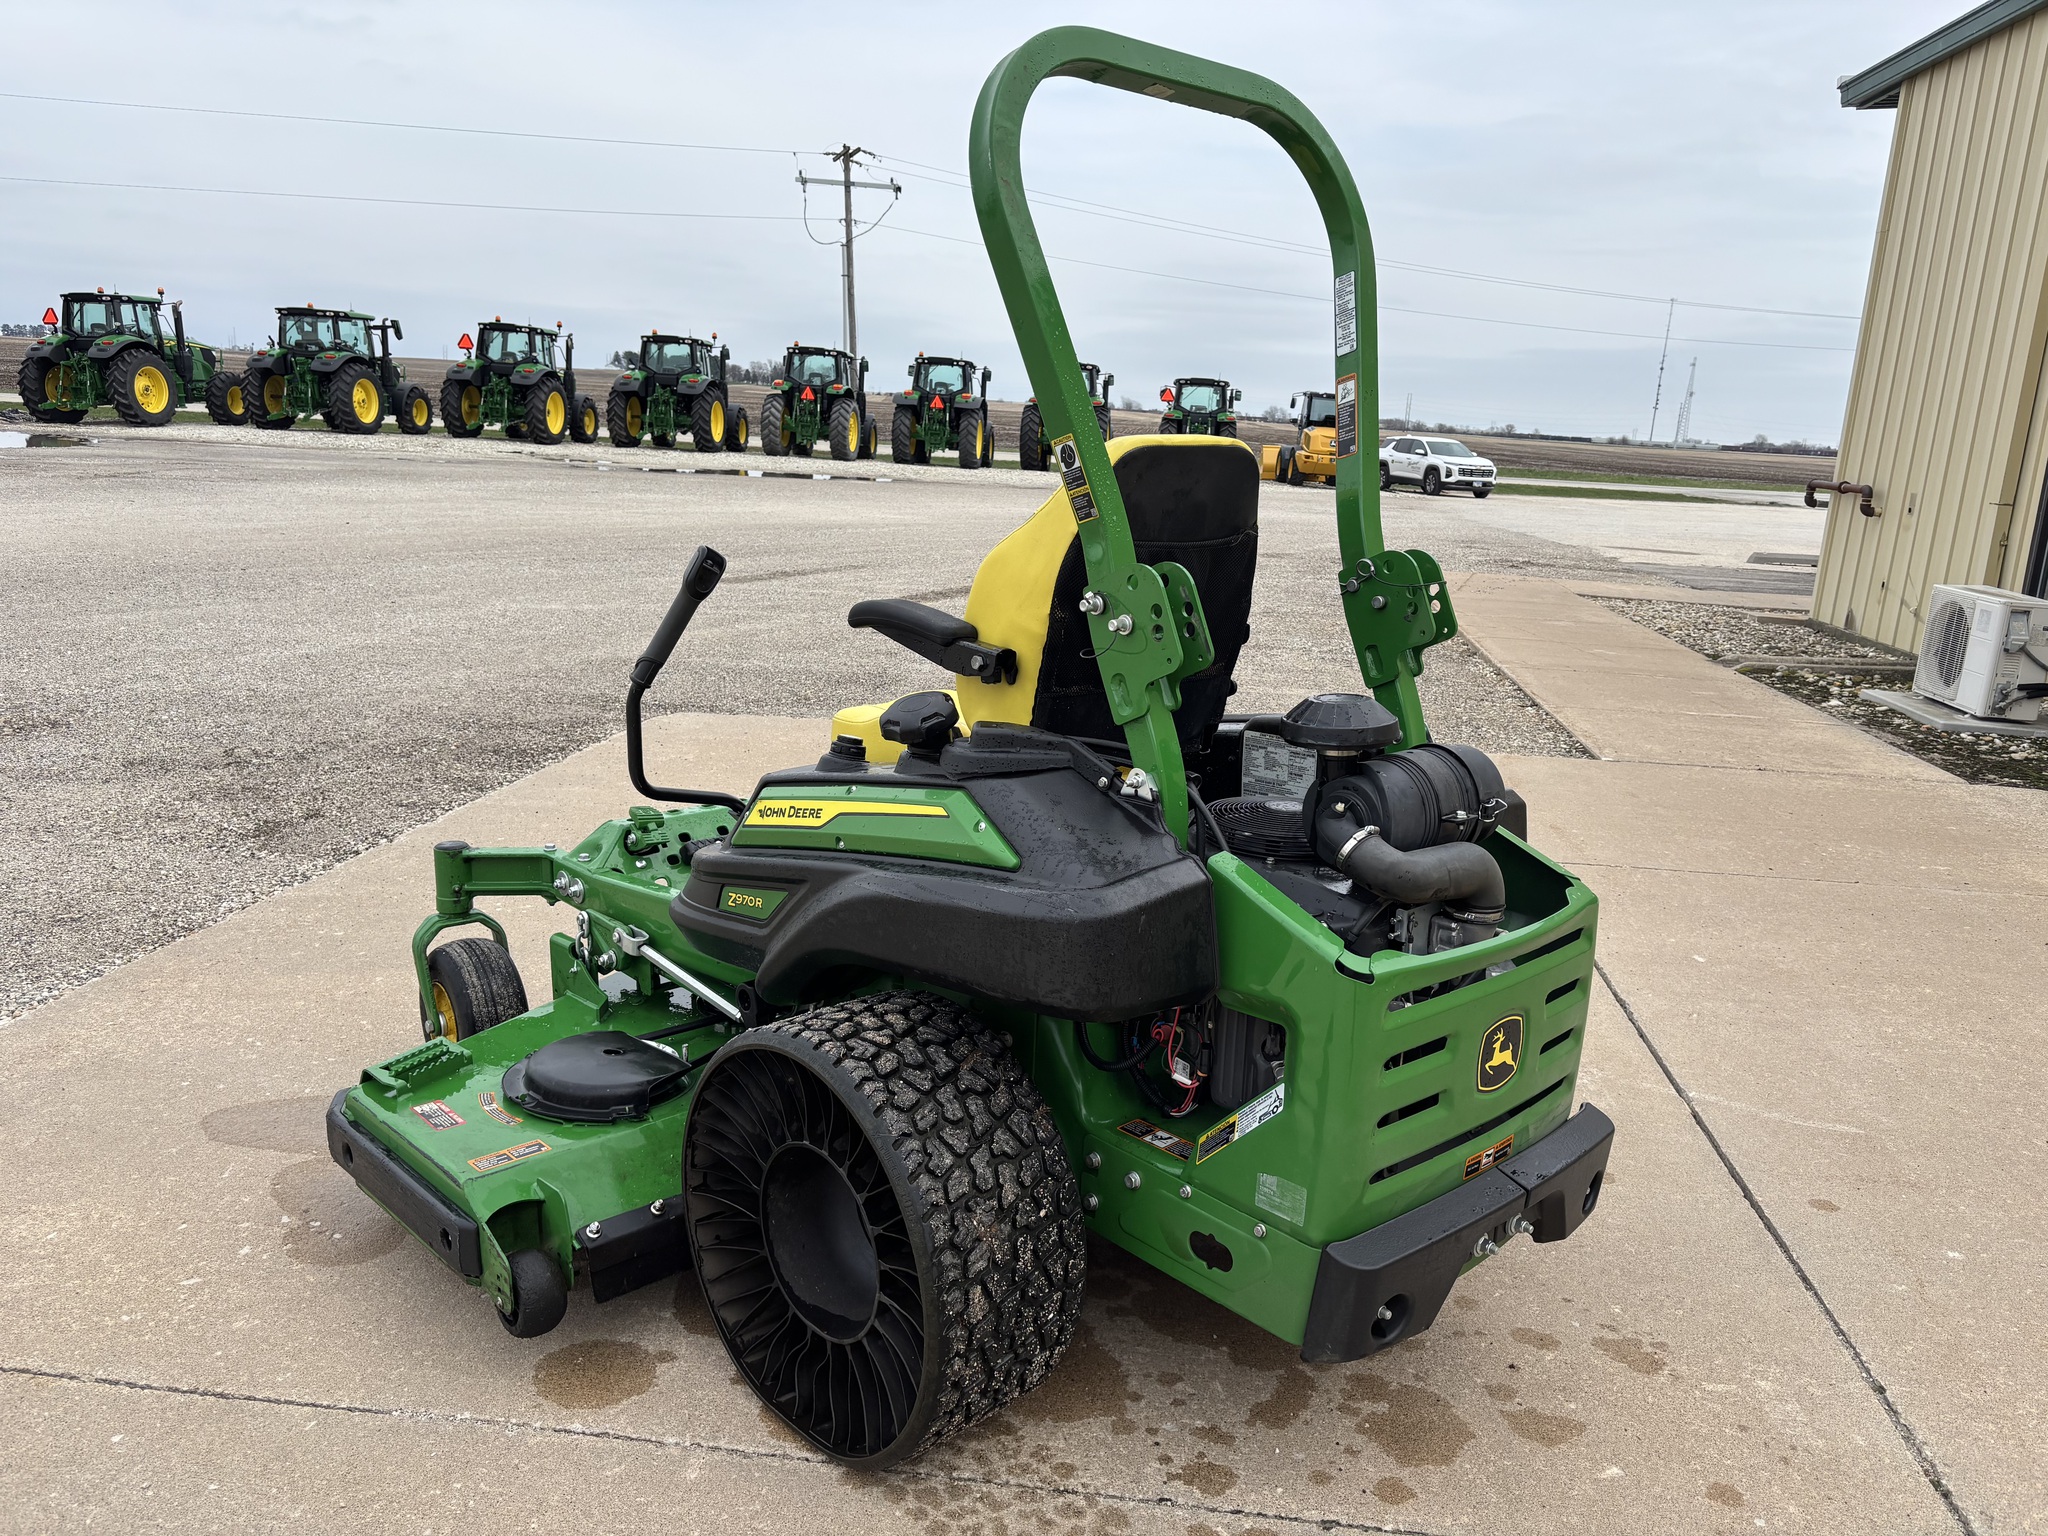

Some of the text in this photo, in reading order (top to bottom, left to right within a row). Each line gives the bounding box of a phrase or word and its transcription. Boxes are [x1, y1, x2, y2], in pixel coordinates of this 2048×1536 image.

[761, 805, 823, 819] JOHN DEERE
[728, 892, 763, 909] Z970R
